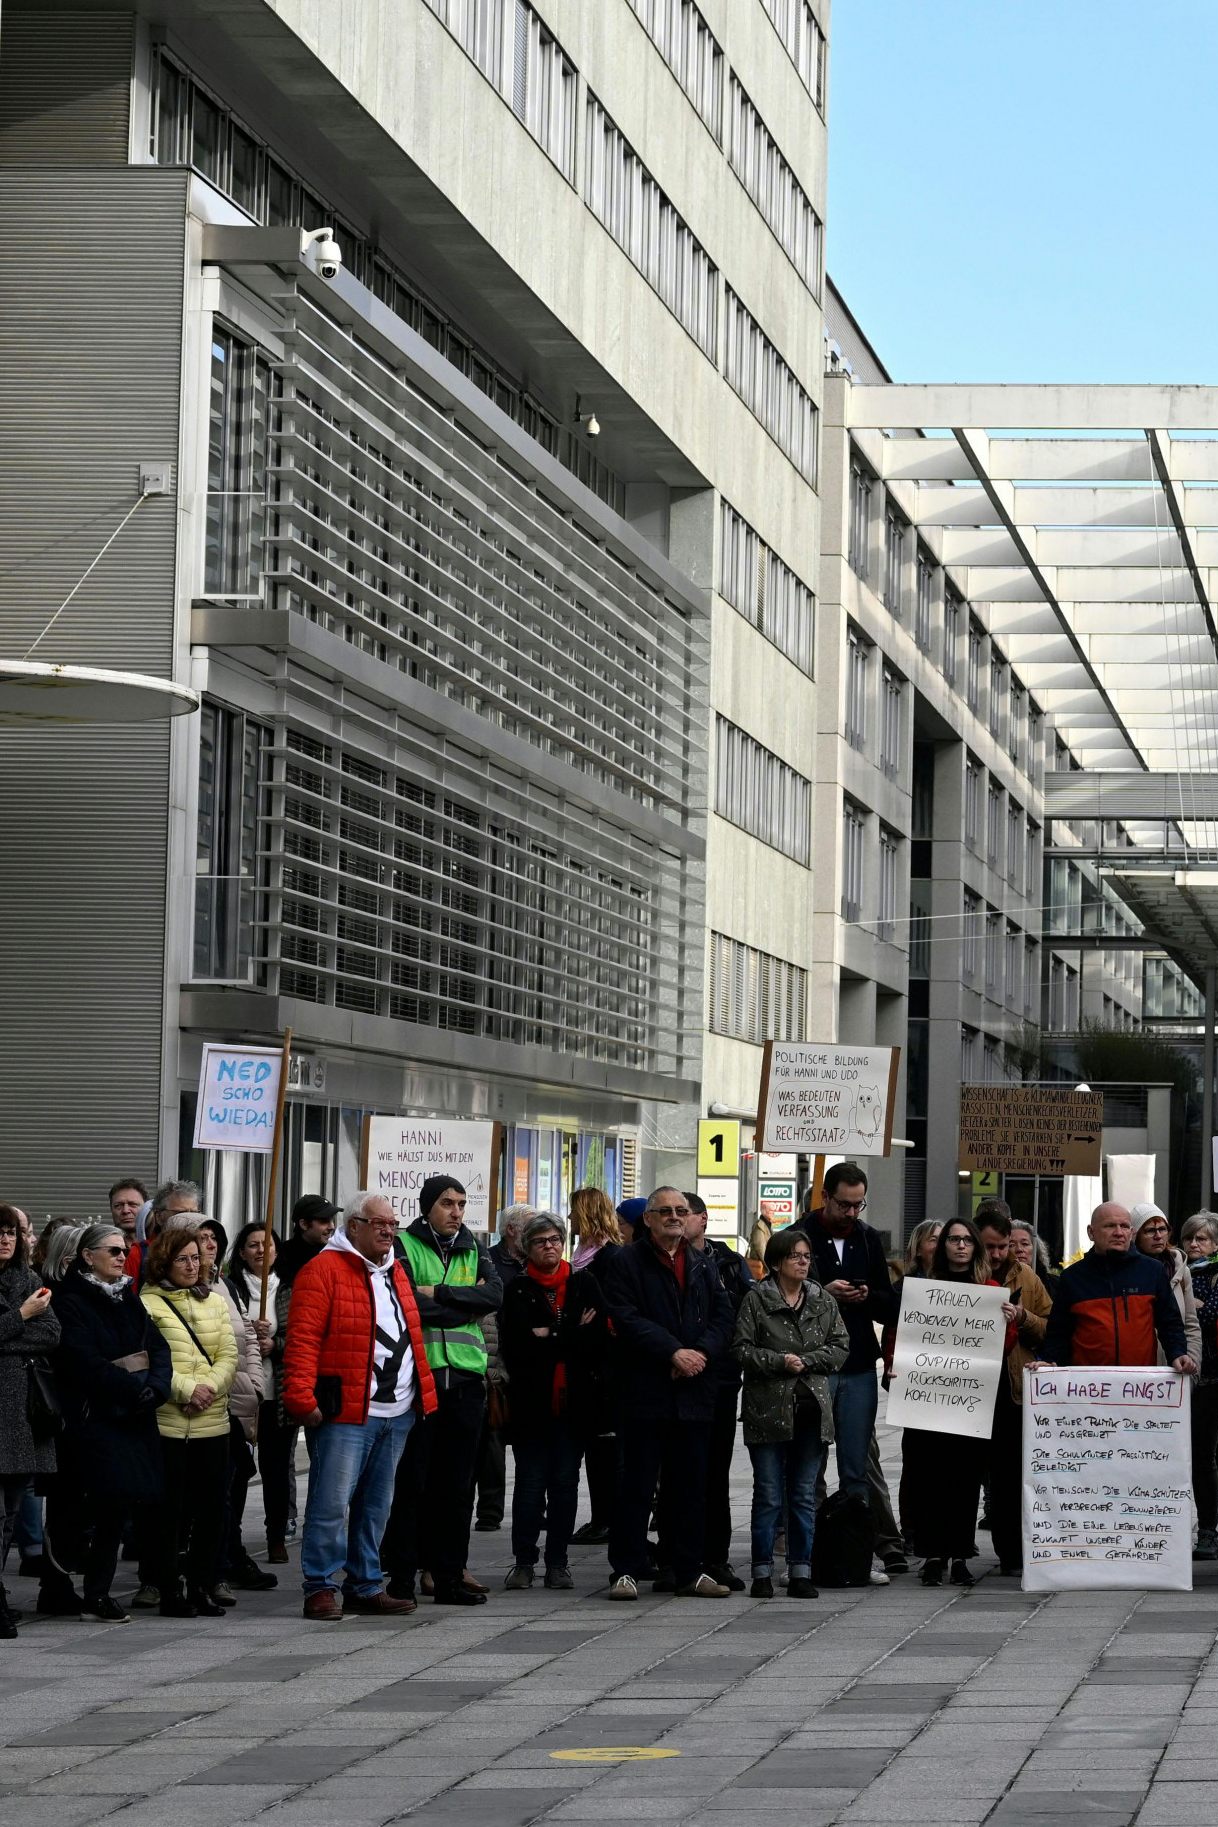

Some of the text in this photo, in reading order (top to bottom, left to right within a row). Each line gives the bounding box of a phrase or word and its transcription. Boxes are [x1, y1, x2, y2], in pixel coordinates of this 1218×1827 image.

[775, 1051, 869, 1066] POLITISCHE BILDUNG
[217, 1060, 272, 1083] NED
[775, 1065, 858, 1080] FÜR HANNI UND UDO
[222, 1088, 263, 1101] SCHO
[779, 1090, 841, 1102] WAS BEDEUTEN
[208, 1107, 274, 1127] WIEDA!
[778, 1104, 839, 1118] VERFASSUNG
[401, 1128, 442, 1146] HANNI
[776, 1126, 846, 1142] RECHTSSTAAT?
[709, 1133, 724, 1162] 1
[1033, 1145, 1061, 1157] UNSERE
[378, 1151, 393, 1161] WIE
[445, 1152, 458, 1163] MIT
[458, 1153, 474, 1163] DEN
[763, 1187, 790, 1196] LOTTO
[926, 1288, 981, 1307] FRAUEN
[904, 1310, 996, 1332] VERDIENEN MEHR
[922, 1332, 984, 1347] ALS DIESE
[916, 1353, 971, 1370] ÖVP/FPÖ
[908, 1371, 984, 1389] RÜCKSCHRITTS-
[1035, 1378, 1176, 1401] ICH HABE ANGST
[1034, 1414, 1180, 1429] VOR EINER POLITIK DIE SPALTET
[1035, 1431, 1116, 1439] UND AUSGRENZT
[1032, 1448, 1170, 1460] DIE SCHULKINDER RASSISTISCH
[1031, 1461, 1088, 1472] BELEIDIGT
[1033, 1485, 1047, 1495] VOR
[1052, 1486, 1099, 1494] MENSCHEN
[1103, 1486, 1120, 1496] DIE
[1033, 1501, 1051, 1512] ALS
[1060, 1502, 1114, 1512] VERBRECHER
[1033, 1521, 1052, 1529] UND
[1058, 1519, 1079, 1529] DIE
[1083, 1520, 1107, 1530] EINE
[1032, 1534, 1168, 1550] ZUKUNFT UNSERER KINDER
[1033, 1548, 1164, 1562] UND ENKEL GEFÄHRDET
